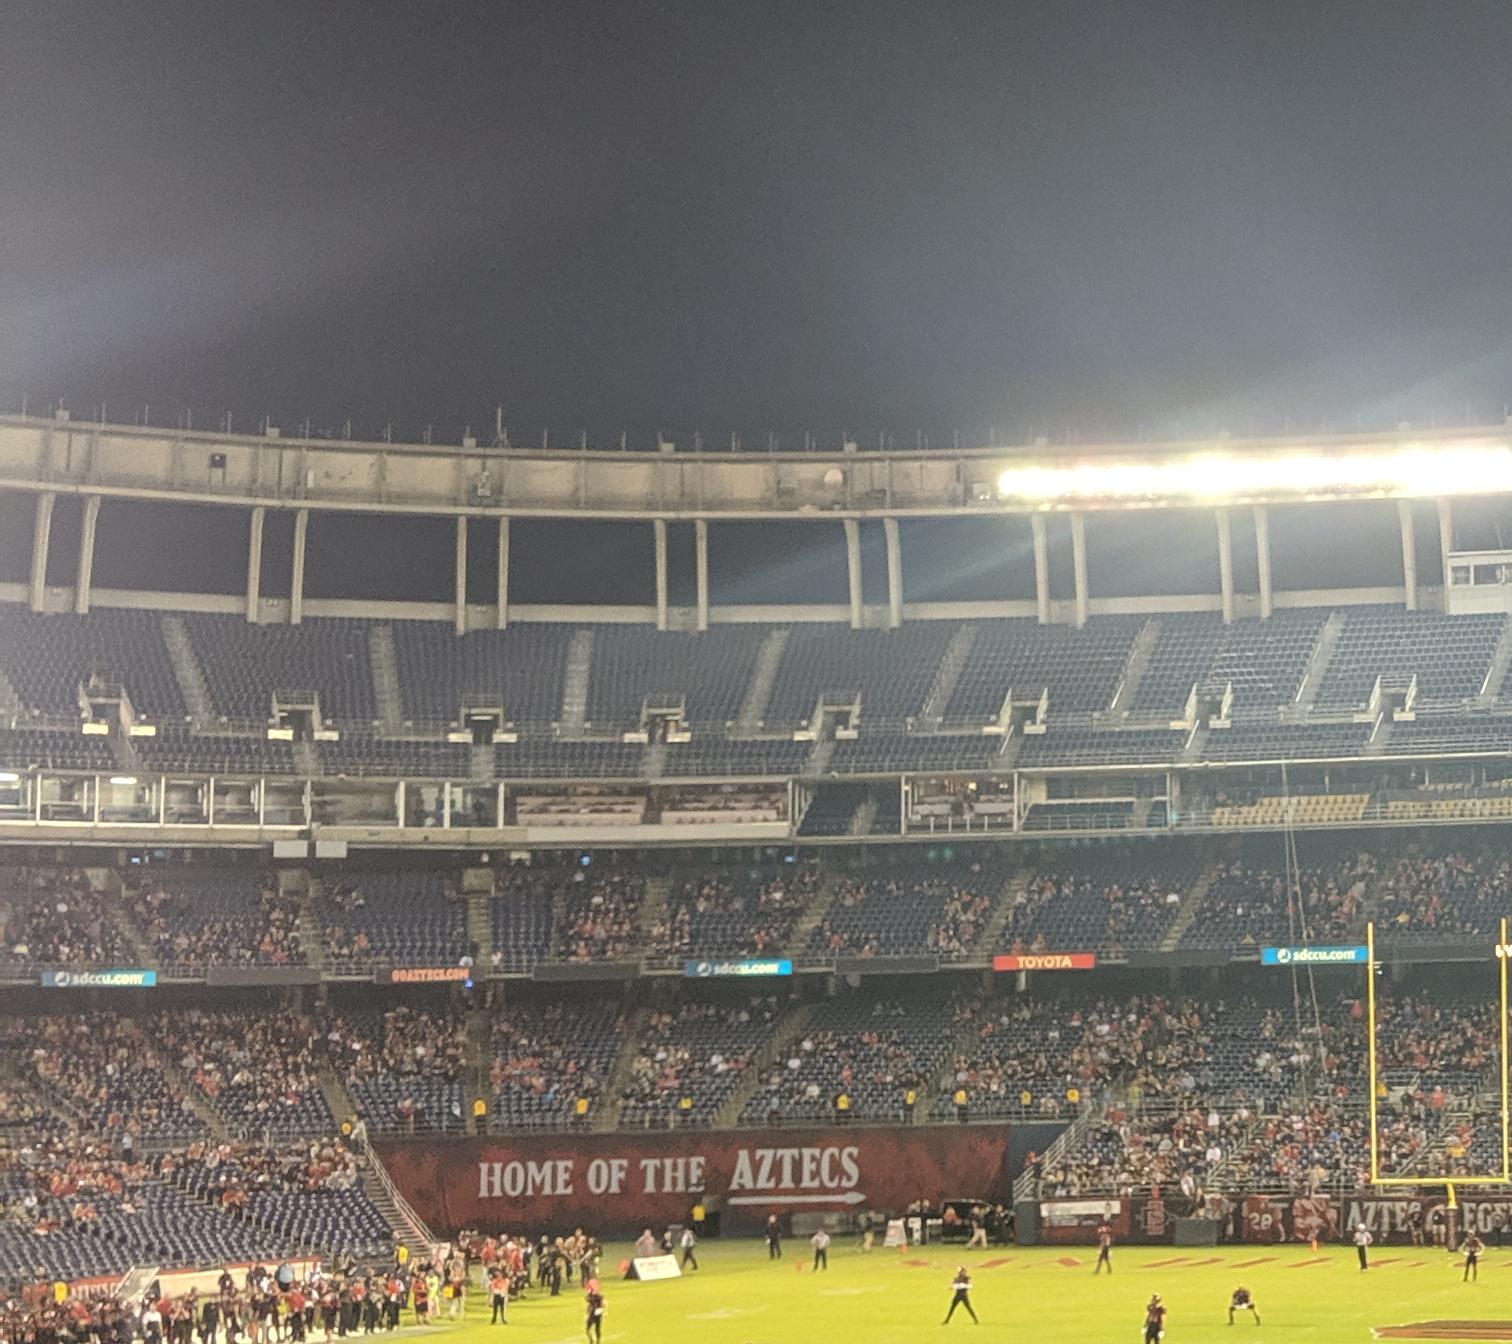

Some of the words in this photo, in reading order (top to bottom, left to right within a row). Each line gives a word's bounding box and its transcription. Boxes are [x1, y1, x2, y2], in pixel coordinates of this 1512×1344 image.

[1016, 955, 1073, 968] TOYOTA
[1293, 948, 1356, 961] sdccu.com
[714, 961, 779, 975] sdccu.com
[72, 972, 143, 986] sdccu.com
[477, 1160, 574, 1198] HOME
[586, 1158, 629, 1194] OF
[639, 1156, 706, 1194] THE
[727, 1146, 861, 1190] AZTECS
